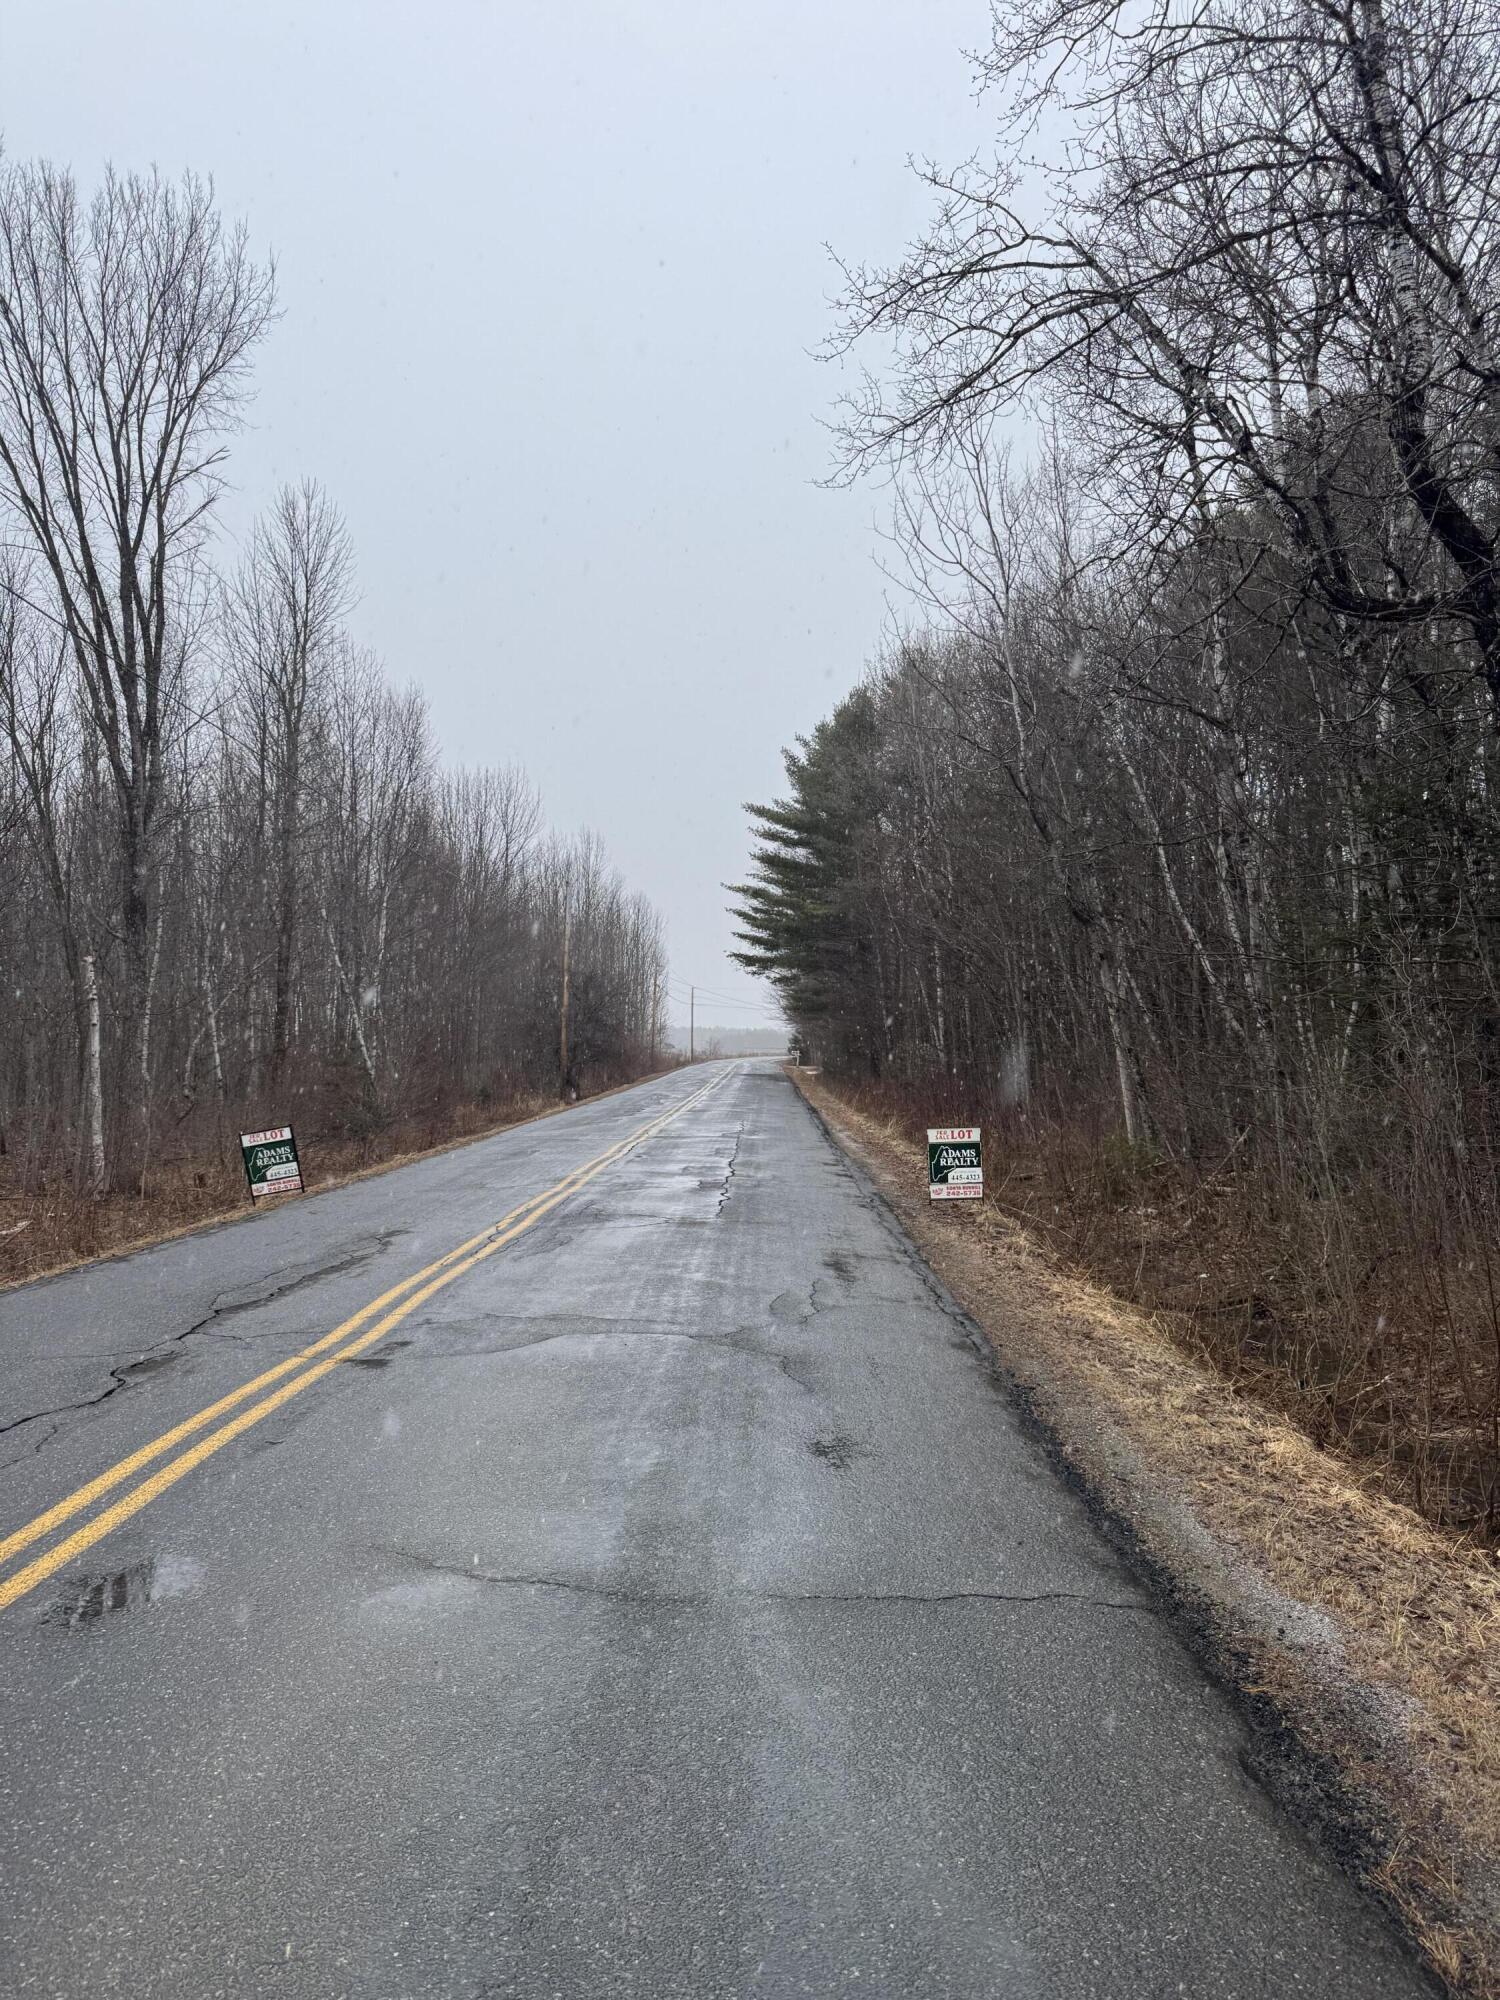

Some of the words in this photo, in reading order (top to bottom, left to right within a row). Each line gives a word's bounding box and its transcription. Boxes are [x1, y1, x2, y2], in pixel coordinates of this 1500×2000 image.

[264, 1129, 284, 1141] LOT
[950, 1130, 973, 1140] LOT
[257, 1146, 290, 1159] ADAMS
[941, 1149, 976, 1158] ADAMS
[256, 1152, 294, 1167] REALTY
[940, 1158, 979, 1166] REALTY
